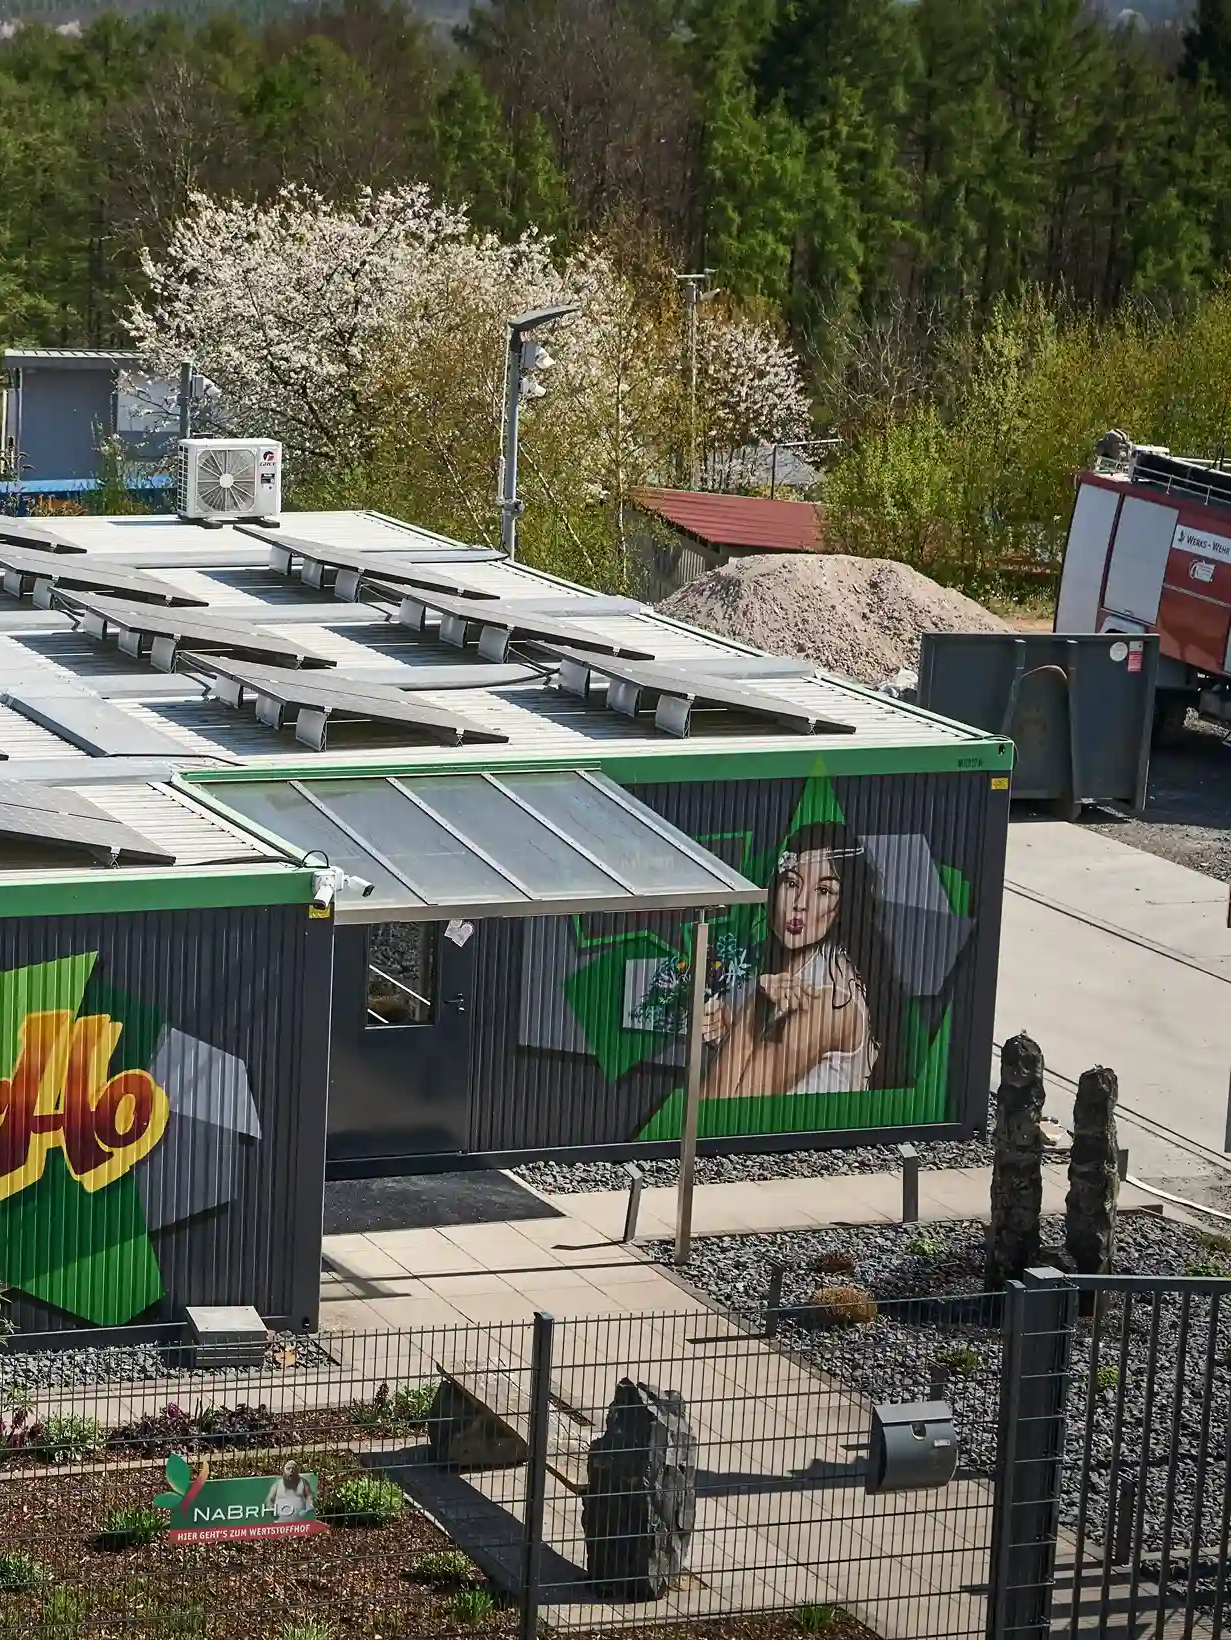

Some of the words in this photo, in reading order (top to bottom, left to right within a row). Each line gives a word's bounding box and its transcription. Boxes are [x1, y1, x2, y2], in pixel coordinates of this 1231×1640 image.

[177, 1532, 198, 1541] HIER
[199, 1530, 228, 1540] GEHT'S
[230, 1529, 247, 1538] ZUM
[249, 1524, 311, 1537] WERTSTOFFHOF
